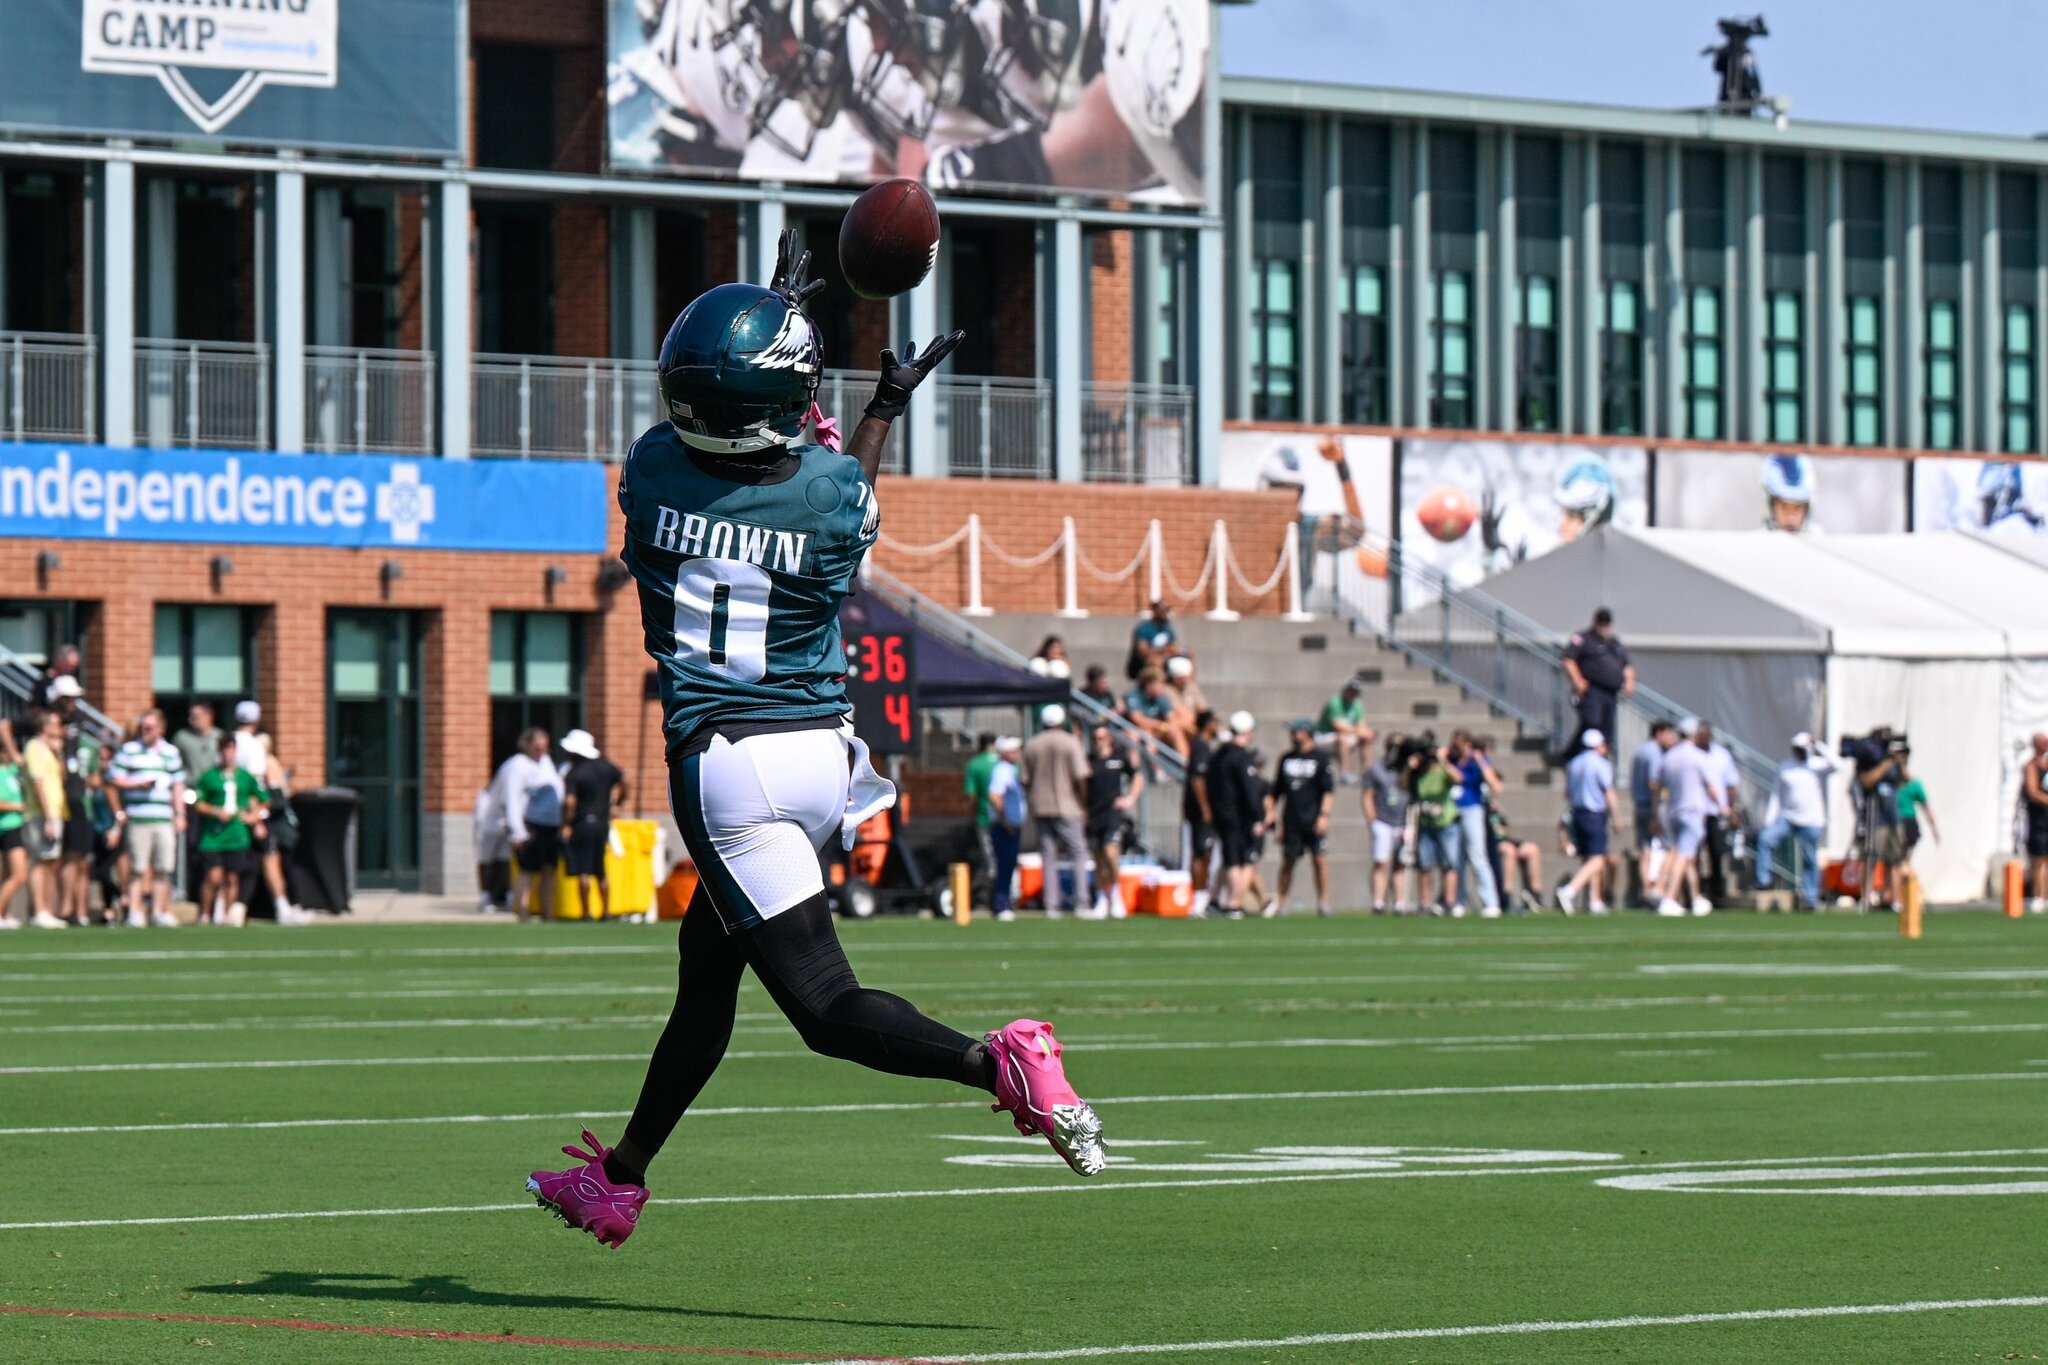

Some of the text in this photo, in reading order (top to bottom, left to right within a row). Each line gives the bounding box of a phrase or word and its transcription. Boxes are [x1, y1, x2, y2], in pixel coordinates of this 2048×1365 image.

[100, 10, 216, 51] CAMP
[1, 450, 368, 536] ndependence
[652, 505, 807, 576] BROWN
[673, 557, 773, 685] 0
[841, 635, 907, 683] :36
[884, 693, 912, 743] 4
